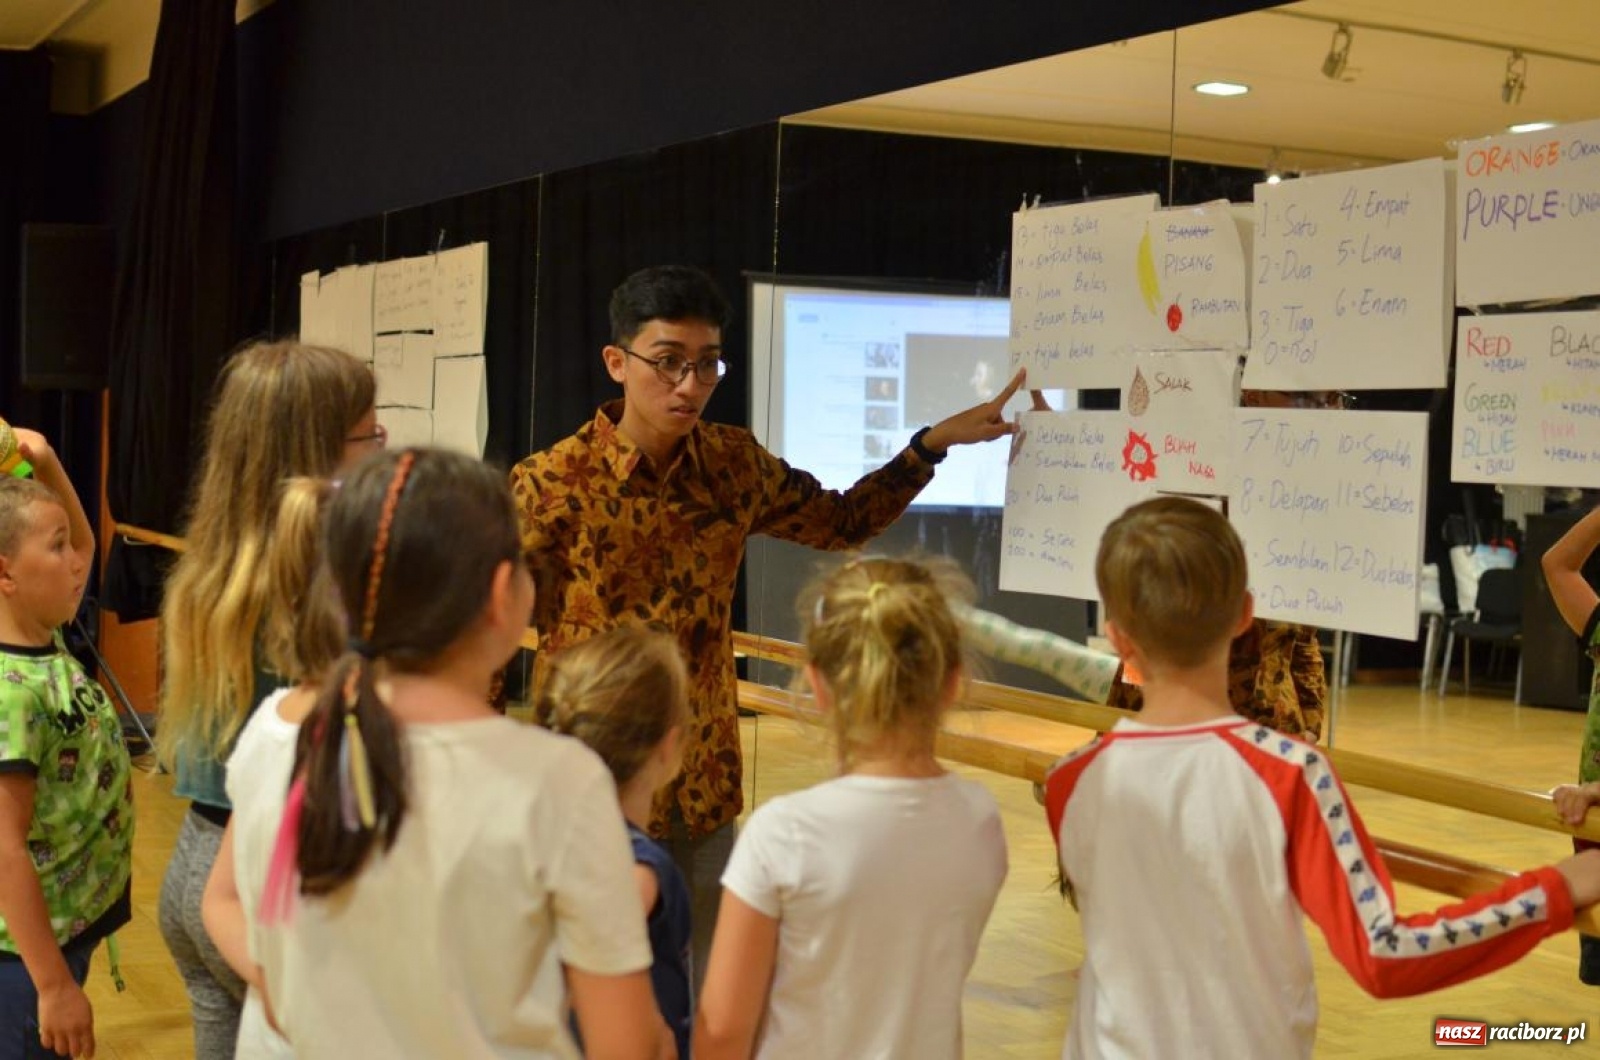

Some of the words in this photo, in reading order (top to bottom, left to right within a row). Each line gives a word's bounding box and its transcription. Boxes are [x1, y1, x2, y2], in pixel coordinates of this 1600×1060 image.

[1466, 141, 1561, 177] ORANGE
[1463, 188, 1559, 242] PURPLE
[1164, 254, 1214, 278] PISANG
[1281, 249, 1313, 281] Dua
[1467, 327, 1512, 357] RED
[1464, 382, 1517, 412] GREEN
[1462, 427, 1516, 458] BLUE
